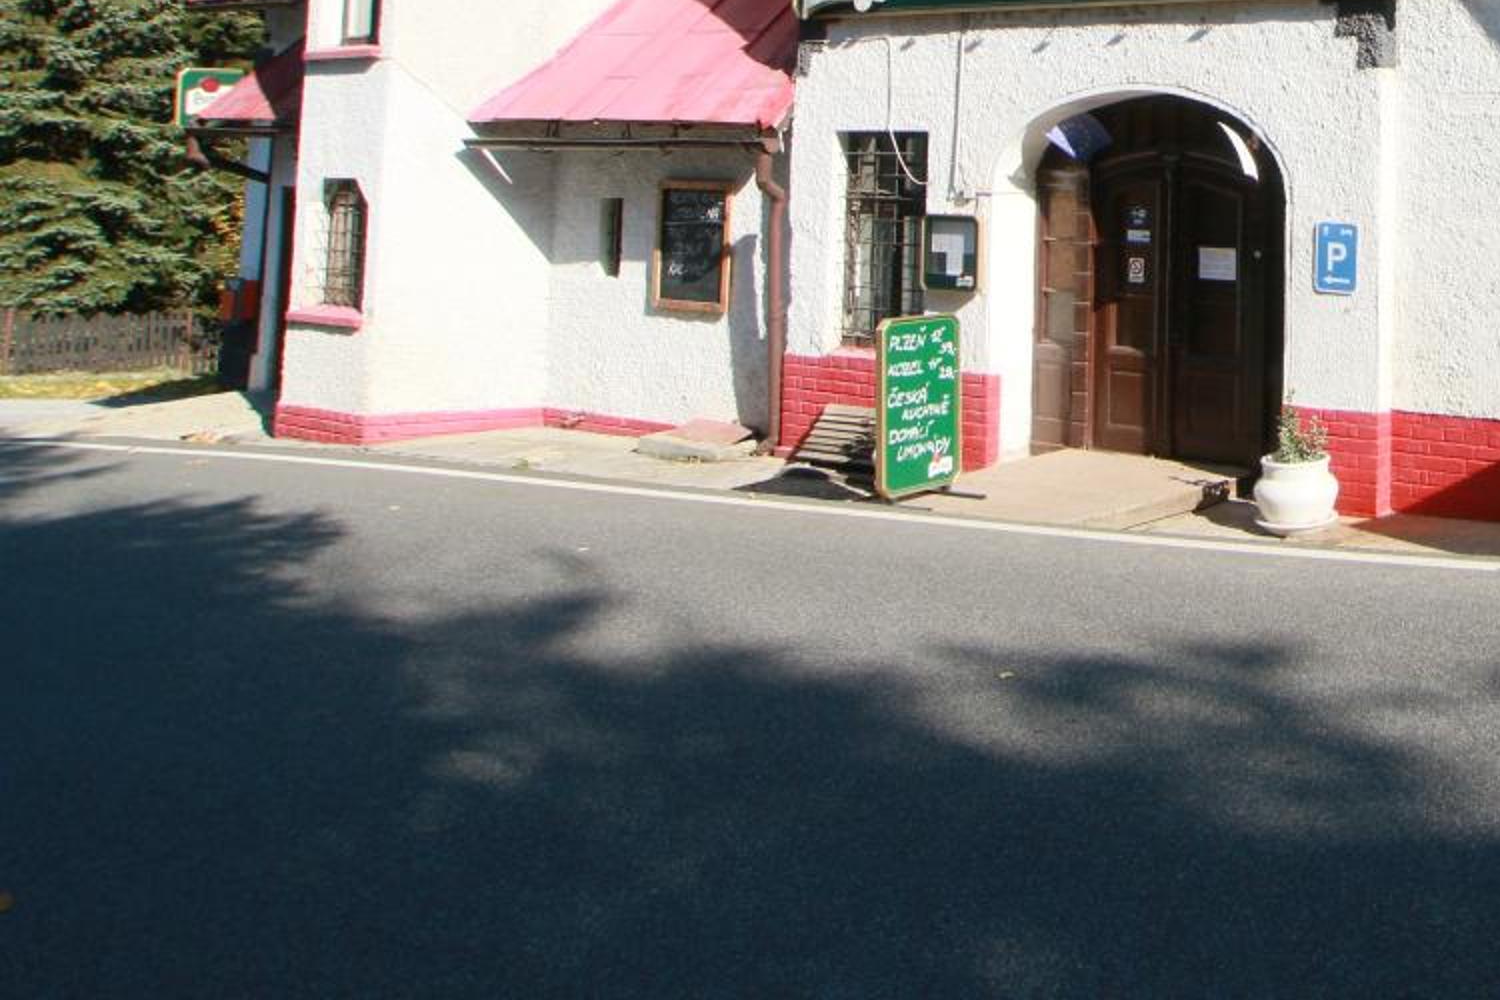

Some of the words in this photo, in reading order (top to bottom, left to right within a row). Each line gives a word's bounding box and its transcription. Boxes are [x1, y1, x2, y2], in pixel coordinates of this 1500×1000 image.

[1327, 241, 1347, 272] P
[887, 325, 928, 352] PLZEŇ
[887, 381, 930, 408] ČESKÁ
